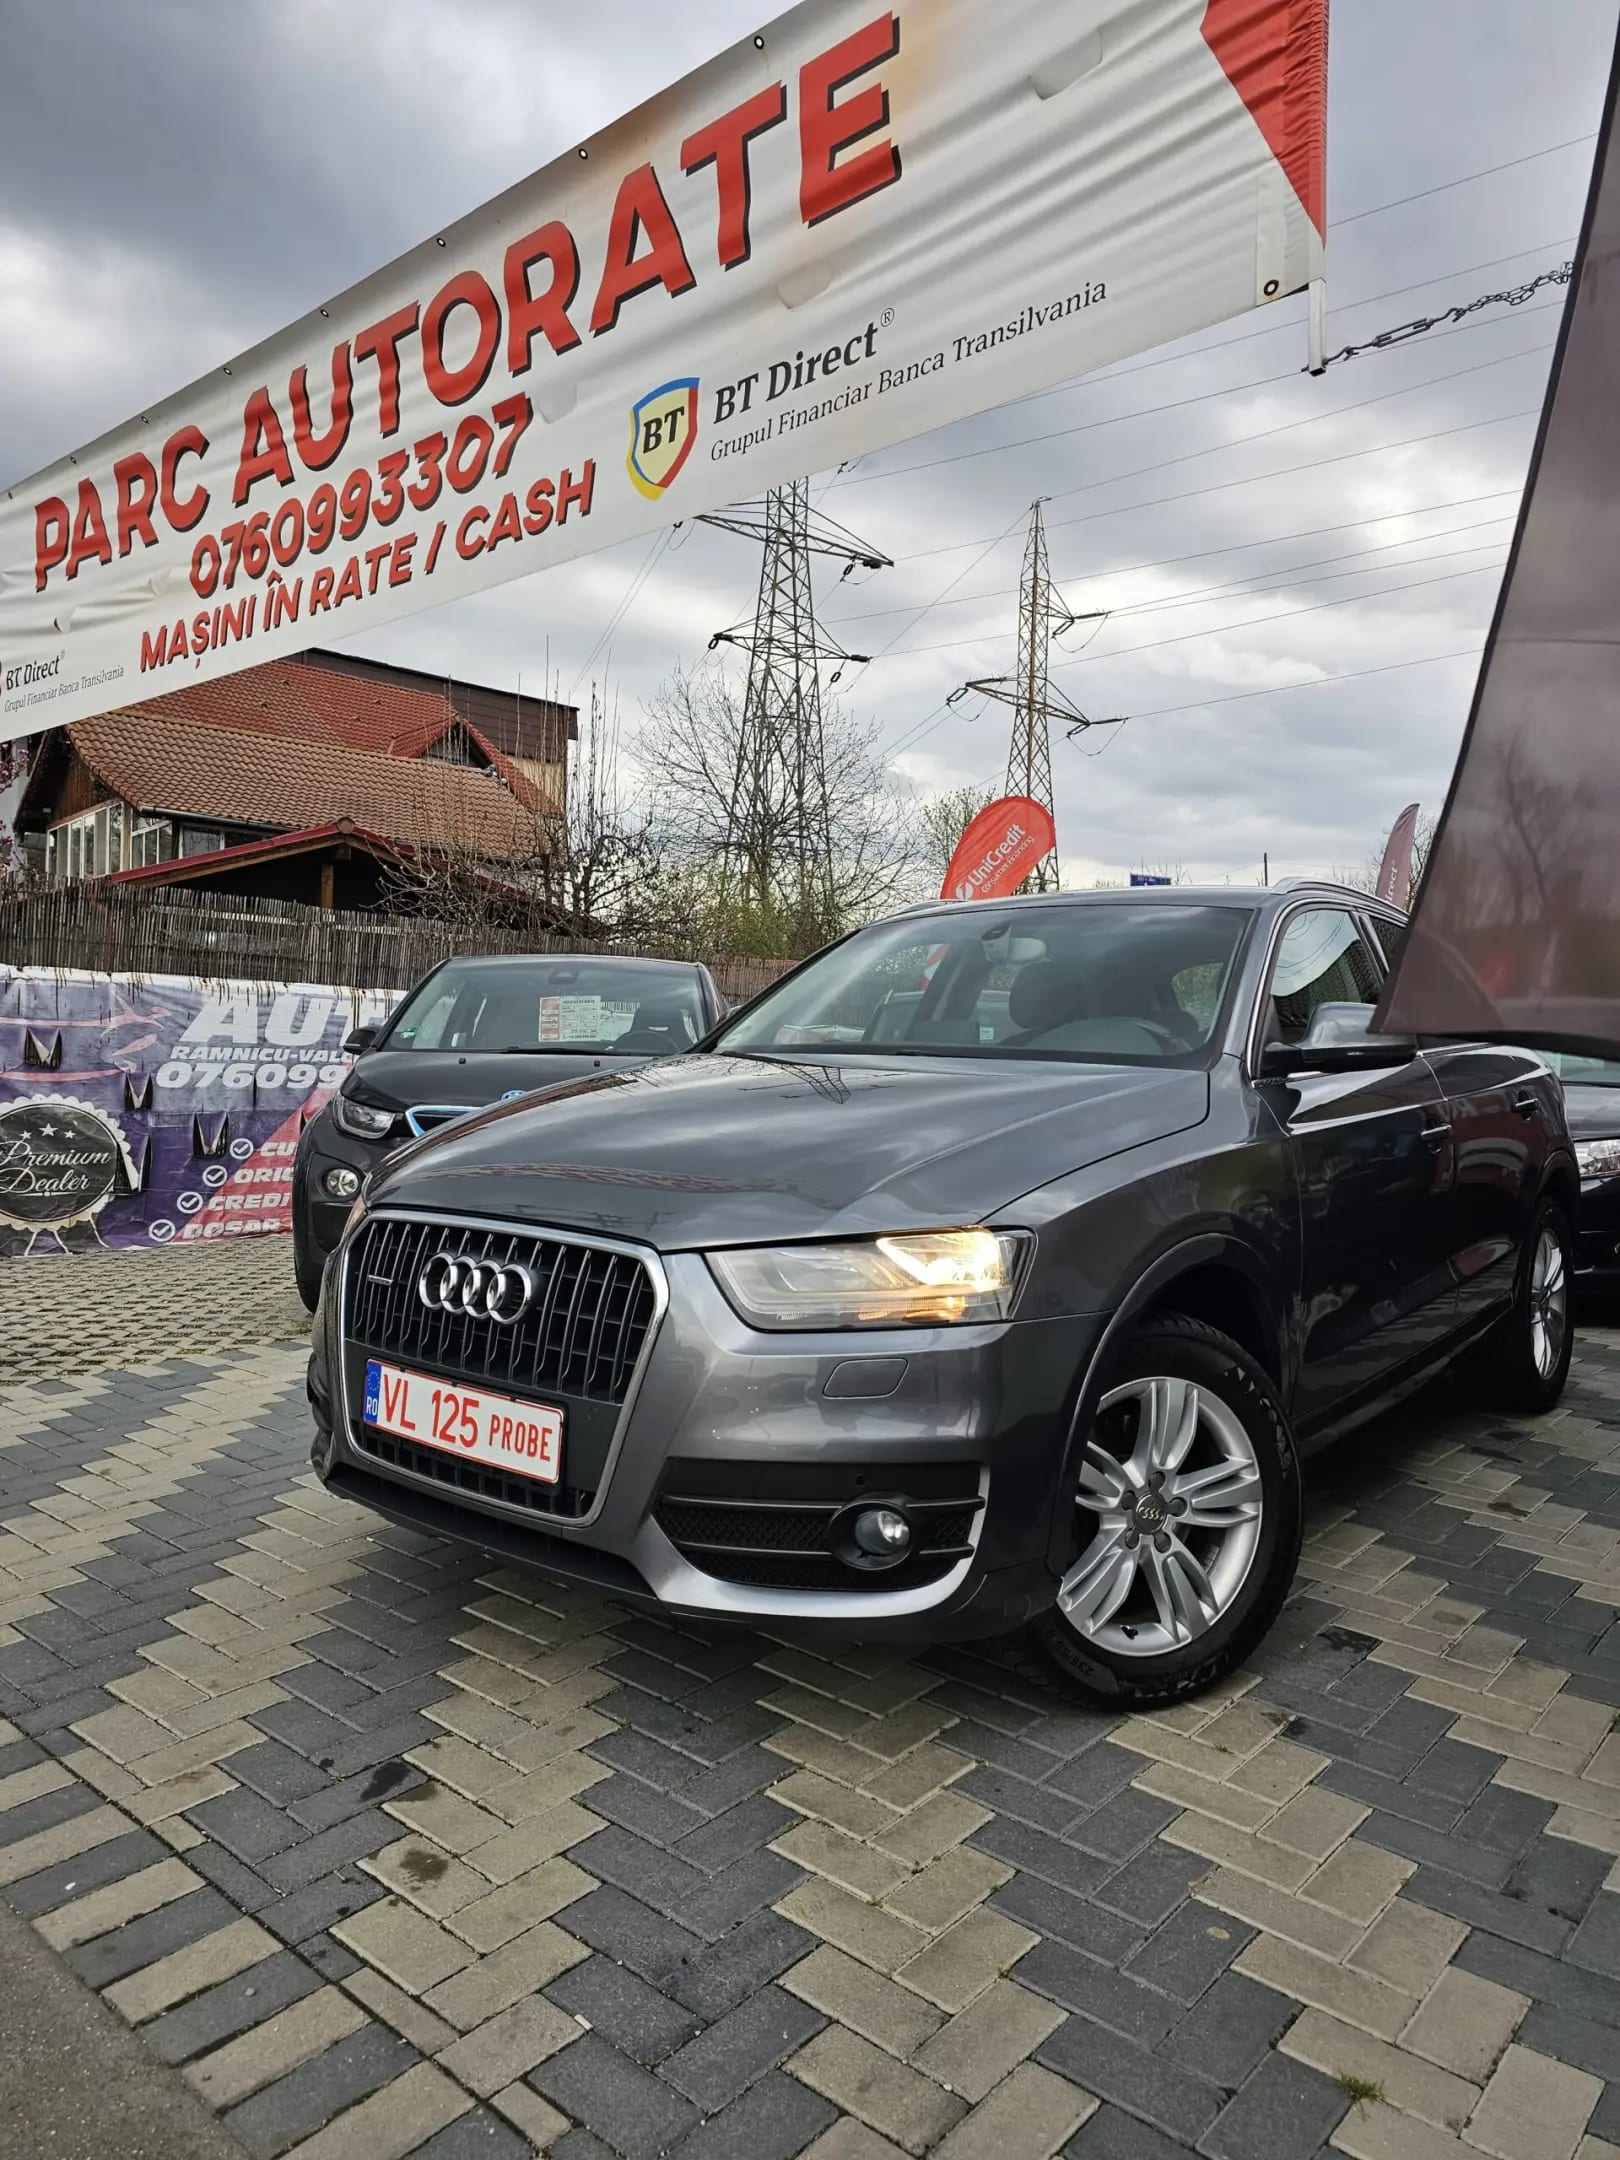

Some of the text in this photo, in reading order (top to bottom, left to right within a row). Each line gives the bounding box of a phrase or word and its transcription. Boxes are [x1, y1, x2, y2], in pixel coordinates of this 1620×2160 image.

[34, 10, 902, 593] PARC AUTORATE
[711, 281, 1107, 461] Grupul Financiar Banca Transilvania
[713, 373, 759, 424] BT
[643, 406, 685, 454] BT
[189, 392, 534, 600] 0760993307
[263, 571, 304, 631] ÎN
[309, 532, 418, 616] RATE
[424, 520, 446, 575] /
[455, 458, 597, 561] CASH
[4, 664, 124, 712] Grupul Financiar Banca Transilvania
[6, 667, 22, 691] BT
[967, 823, 1026, 886] UniCredit
[155, 1061, 348, 1089] 076099
[0, 1140, 111, 1166] Premium
[0, 1167, 91, 1193] Dealer
[208, 1193, 291, 1211] CREDI
[182, 1218, 281, 1239] DOSAR
[366, 1396, 378, 1416] RO
[384, 1374, 552, 1462] VL 125 PROBE
